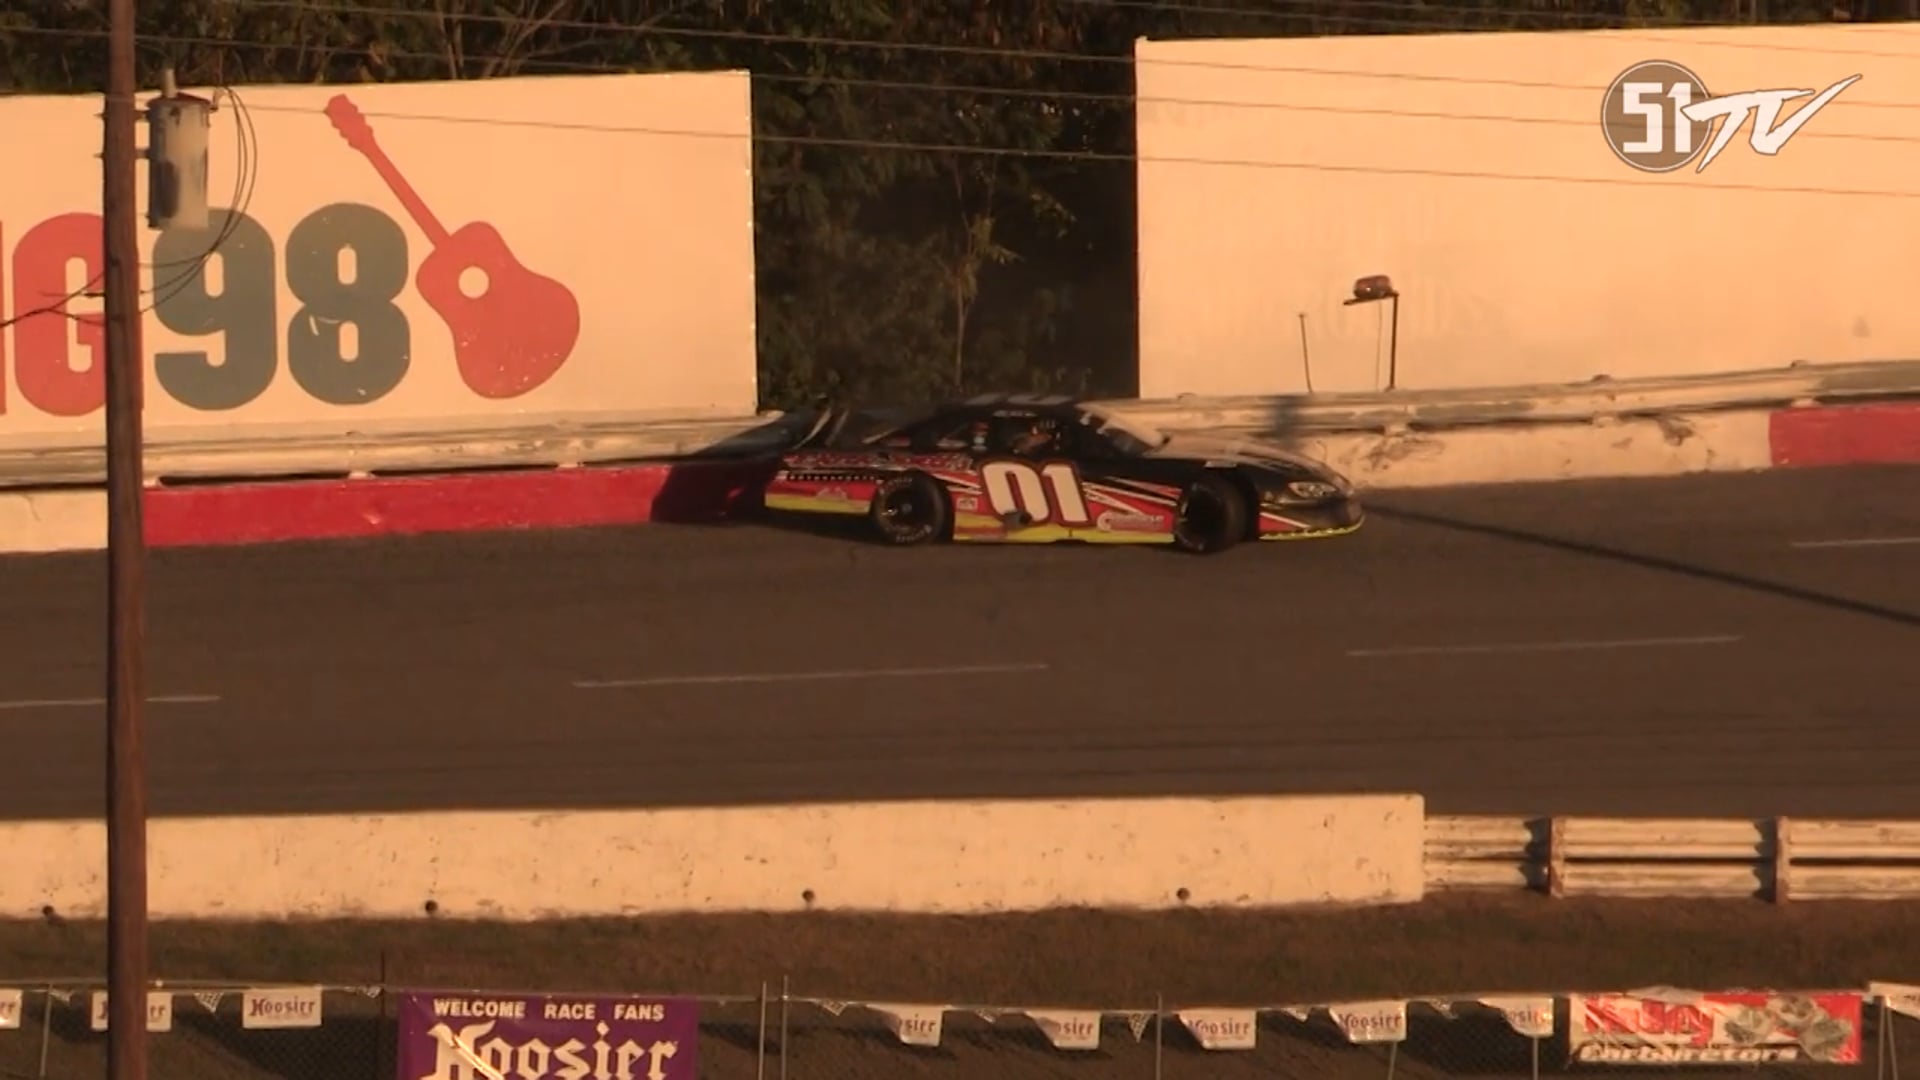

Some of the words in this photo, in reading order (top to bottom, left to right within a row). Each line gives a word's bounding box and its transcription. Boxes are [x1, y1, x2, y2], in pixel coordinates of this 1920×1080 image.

[982, 461, 1089, 523] 01
[249, 998, 316, 1018] Hoosier
[433, 999, 526, 1019] WELCOME
[544, 1003, 596, 1020] RACE
[614, 1004, 665, 1021] FANS
[419, 1020, 679, 1080] Hoosier
